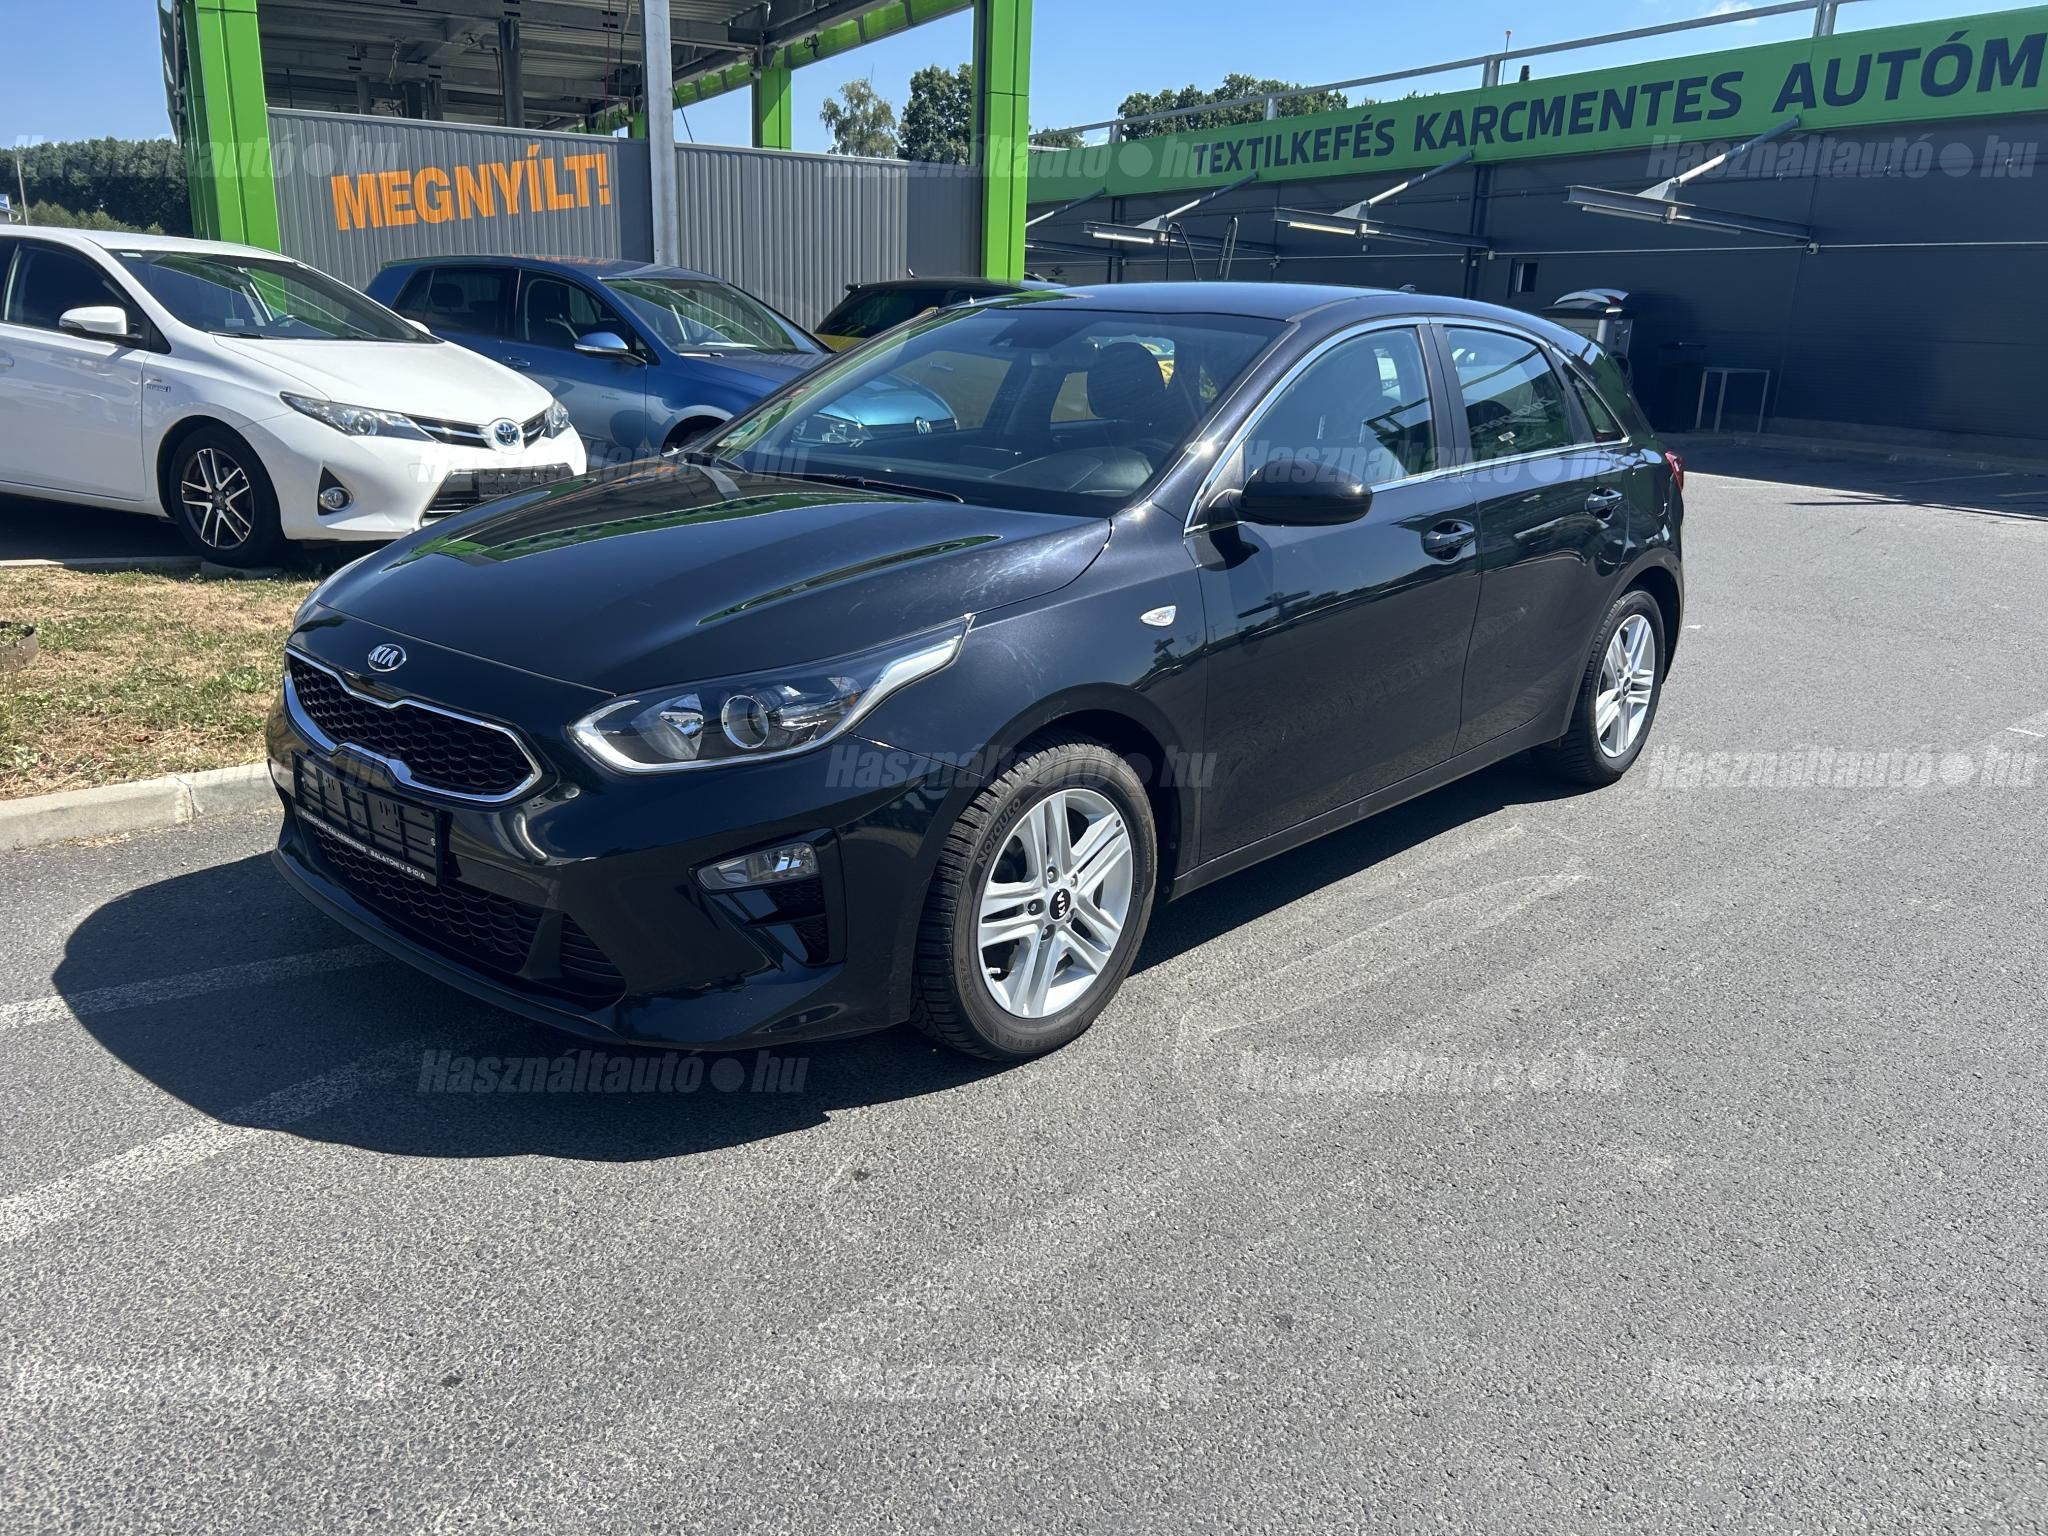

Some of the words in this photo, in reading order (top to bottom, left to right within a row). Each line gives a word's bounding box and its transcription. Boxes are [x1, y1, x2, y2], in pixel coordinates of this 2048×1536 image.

[1192, 113, 1396, 175] TEXTILKEFÉS
[1412, 71, 1744, 152] KARCMENTES
[331, 144, 611, 231] MEGNYÍLT!
[369, 645, 399, 668] KIA
[1056, 891, 1067, 917] KIA
